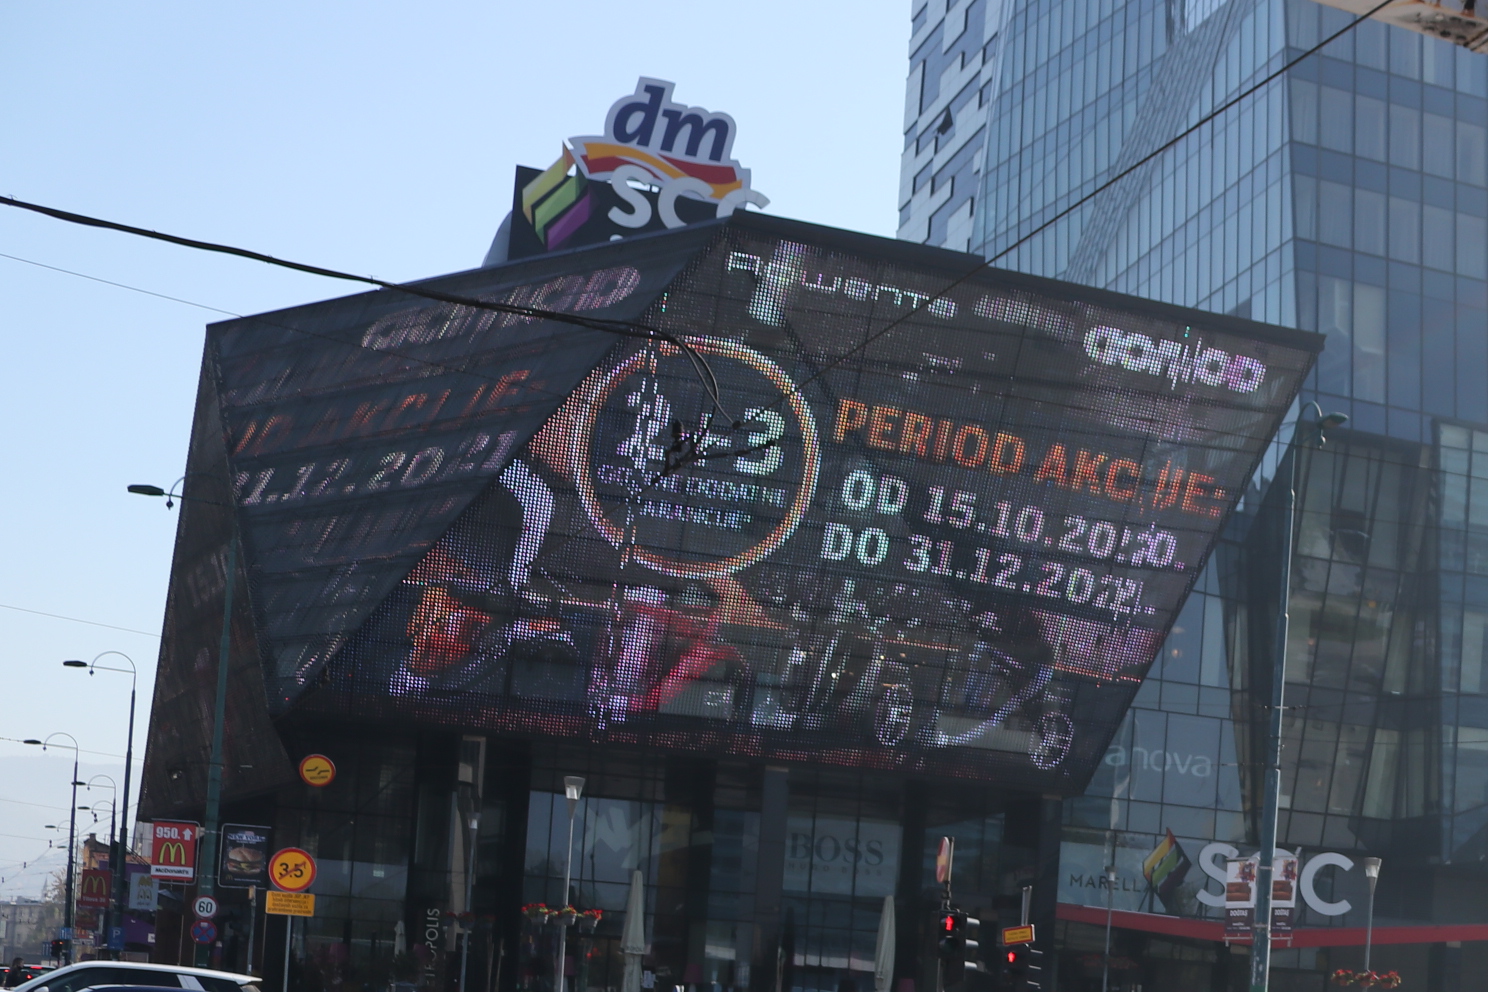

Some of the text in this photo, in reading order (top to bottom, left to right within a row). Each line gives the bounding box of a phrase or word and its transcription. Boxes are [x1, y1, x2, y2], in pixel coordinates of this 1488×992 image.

[612, 83, 729, 162] dm
[832, 397, 1026, 478] PERIOD
[841, 469, 910, 516] OD
[820, 521, 890, 568] DO
[789, 832, 885, 866] BOSS
[1068, 873, 1149, 893] MARELL
[198, 900, 213, 914] 60
